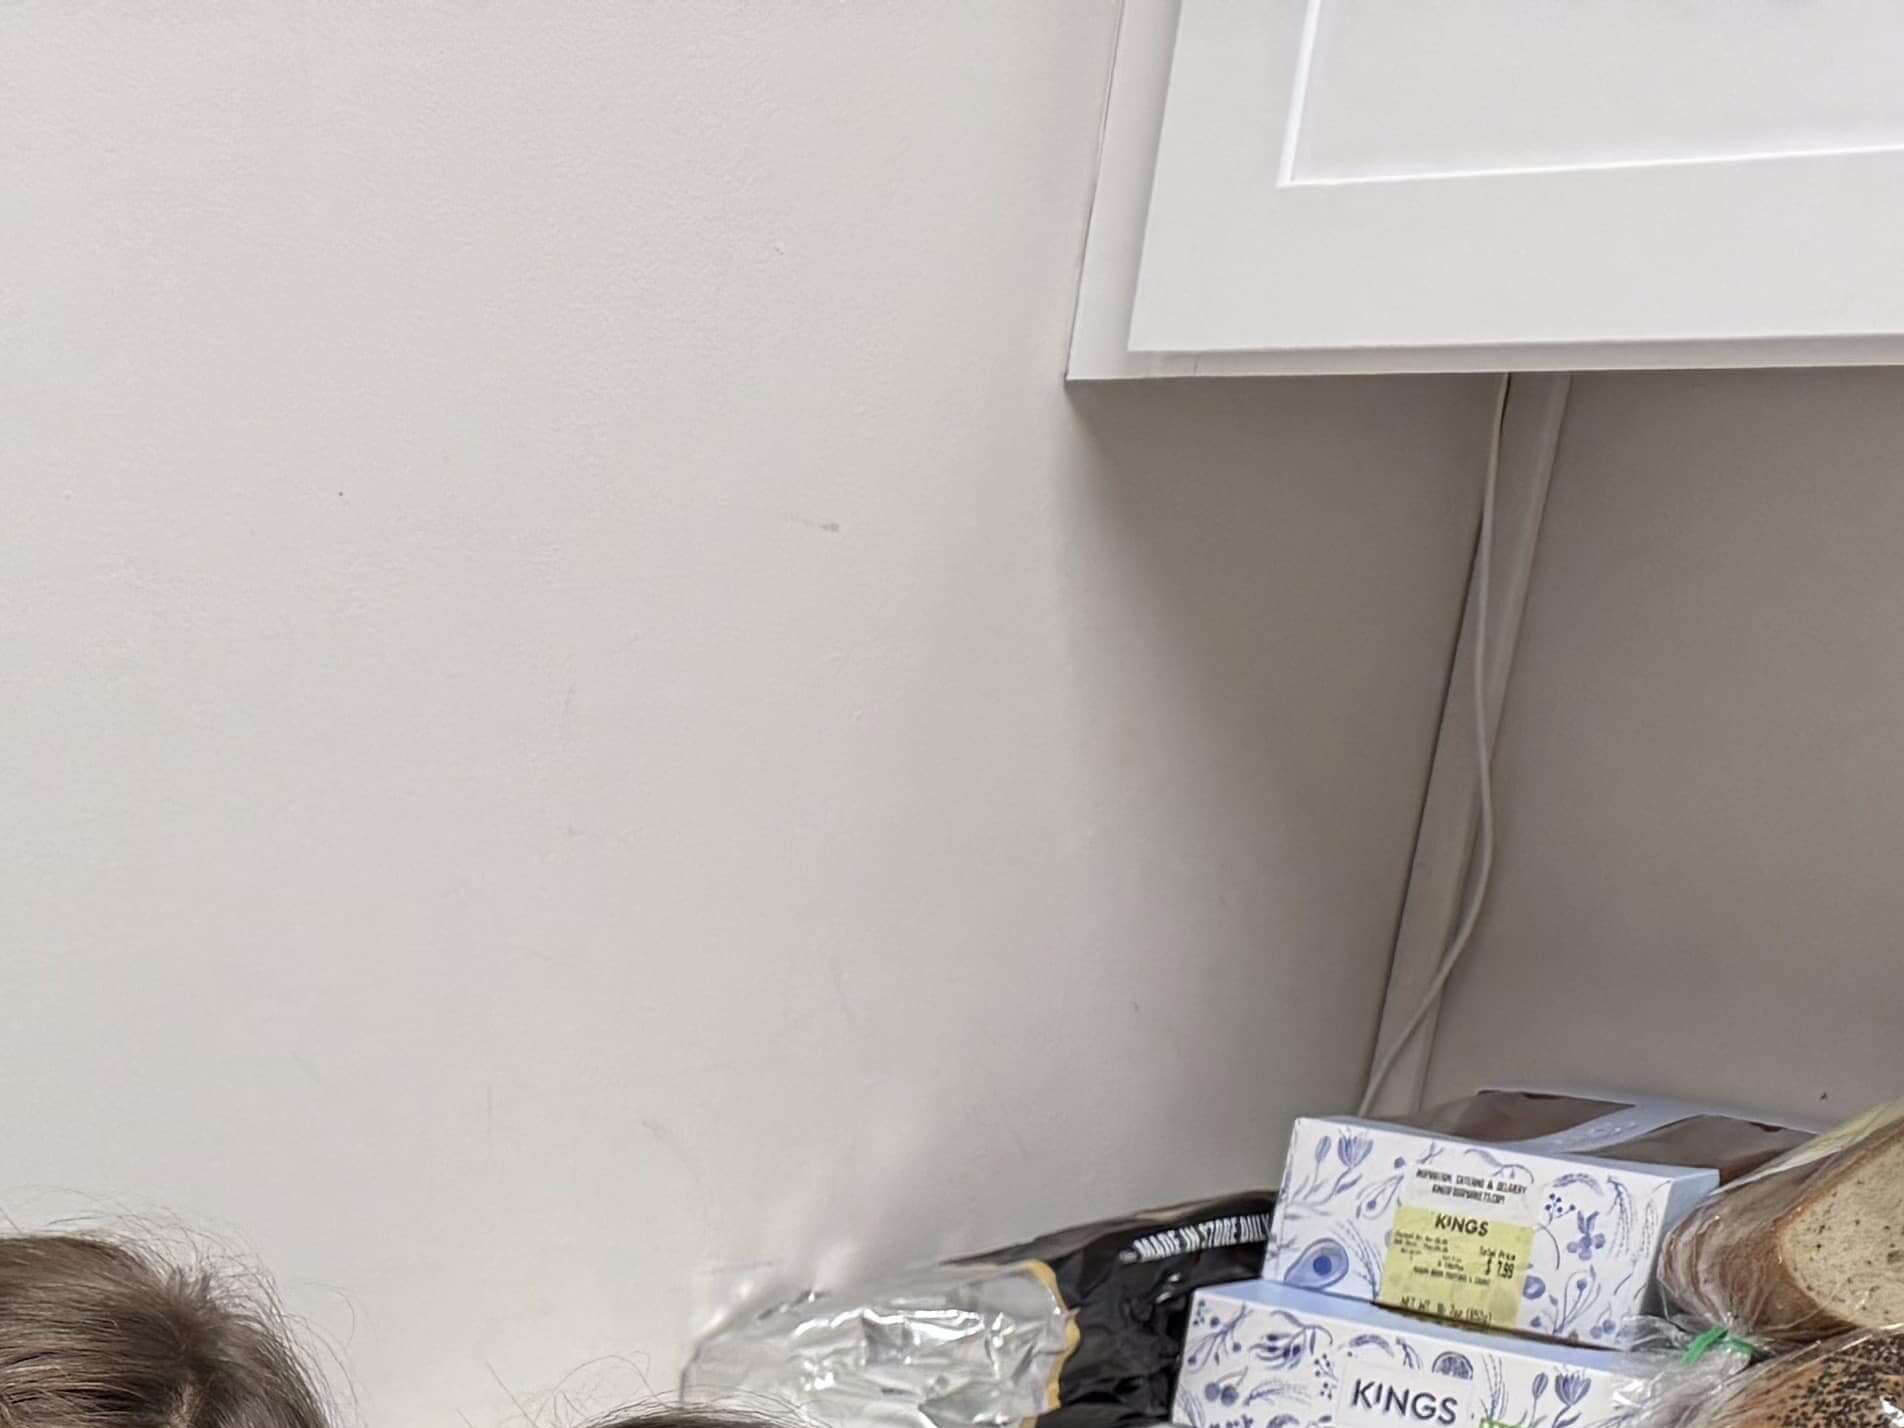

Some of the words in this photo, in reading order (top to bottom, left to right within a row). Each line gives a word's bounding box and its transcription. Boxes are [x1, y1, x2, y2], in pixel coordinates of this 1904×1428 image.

[1132, 1229, 1181, 1263] MADE
[1179, 1224, 1201, 1252] IN
[1198, 1216, 1239, 1249] STORE
[1434, 1212, 1490, 1238] KINGS
[1351, 1377, 1458, 1426] KINGS
